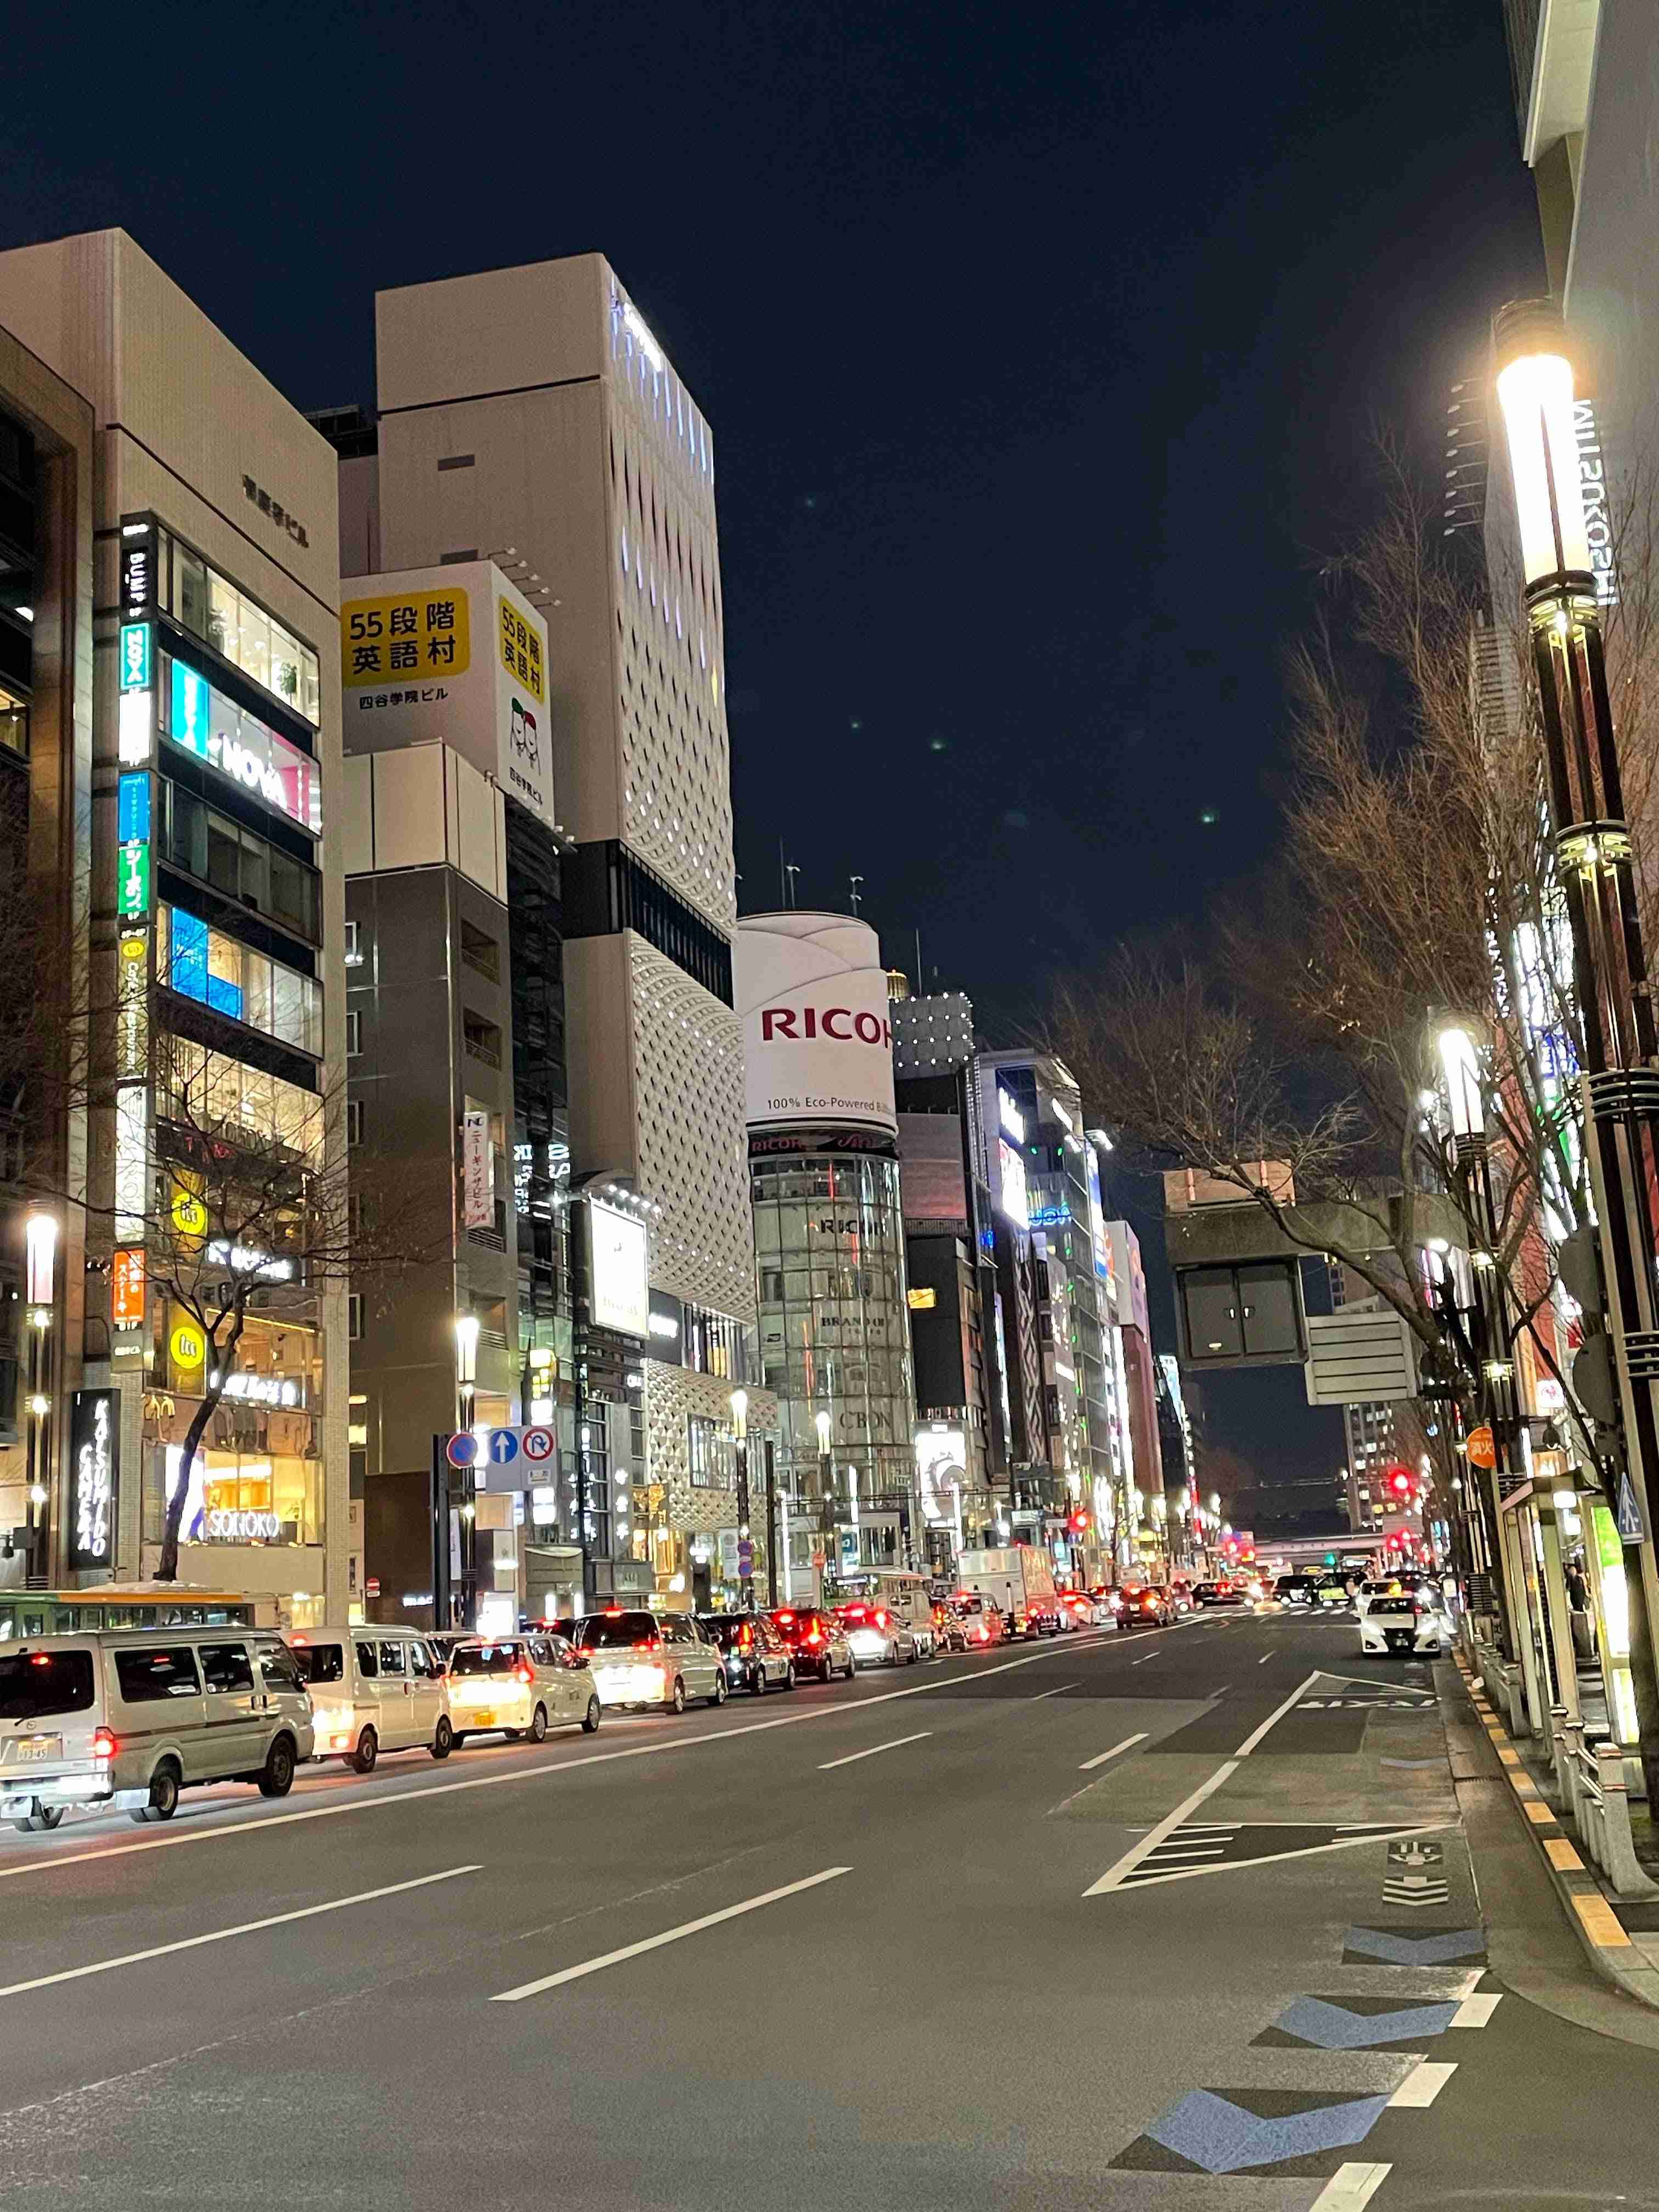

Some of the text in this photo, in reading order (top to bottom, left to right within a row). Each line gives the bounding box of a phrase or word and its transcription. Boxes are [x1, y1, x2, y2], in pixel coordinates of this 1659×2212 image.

[350, 602, 455, 640] 55段階
[503, 606, 539, 664] 55段階
[353, 635, 456, 674] 英語村
[505, 638, 540, 695] 英語村
[359, 687, 448, 709] 四谷学院ビル
[768, 1098, 800, 1109] 100%
[806, 1097, 874, 1111] Eco-Powered
[210, 1511, 279, 1538] SONOKO
